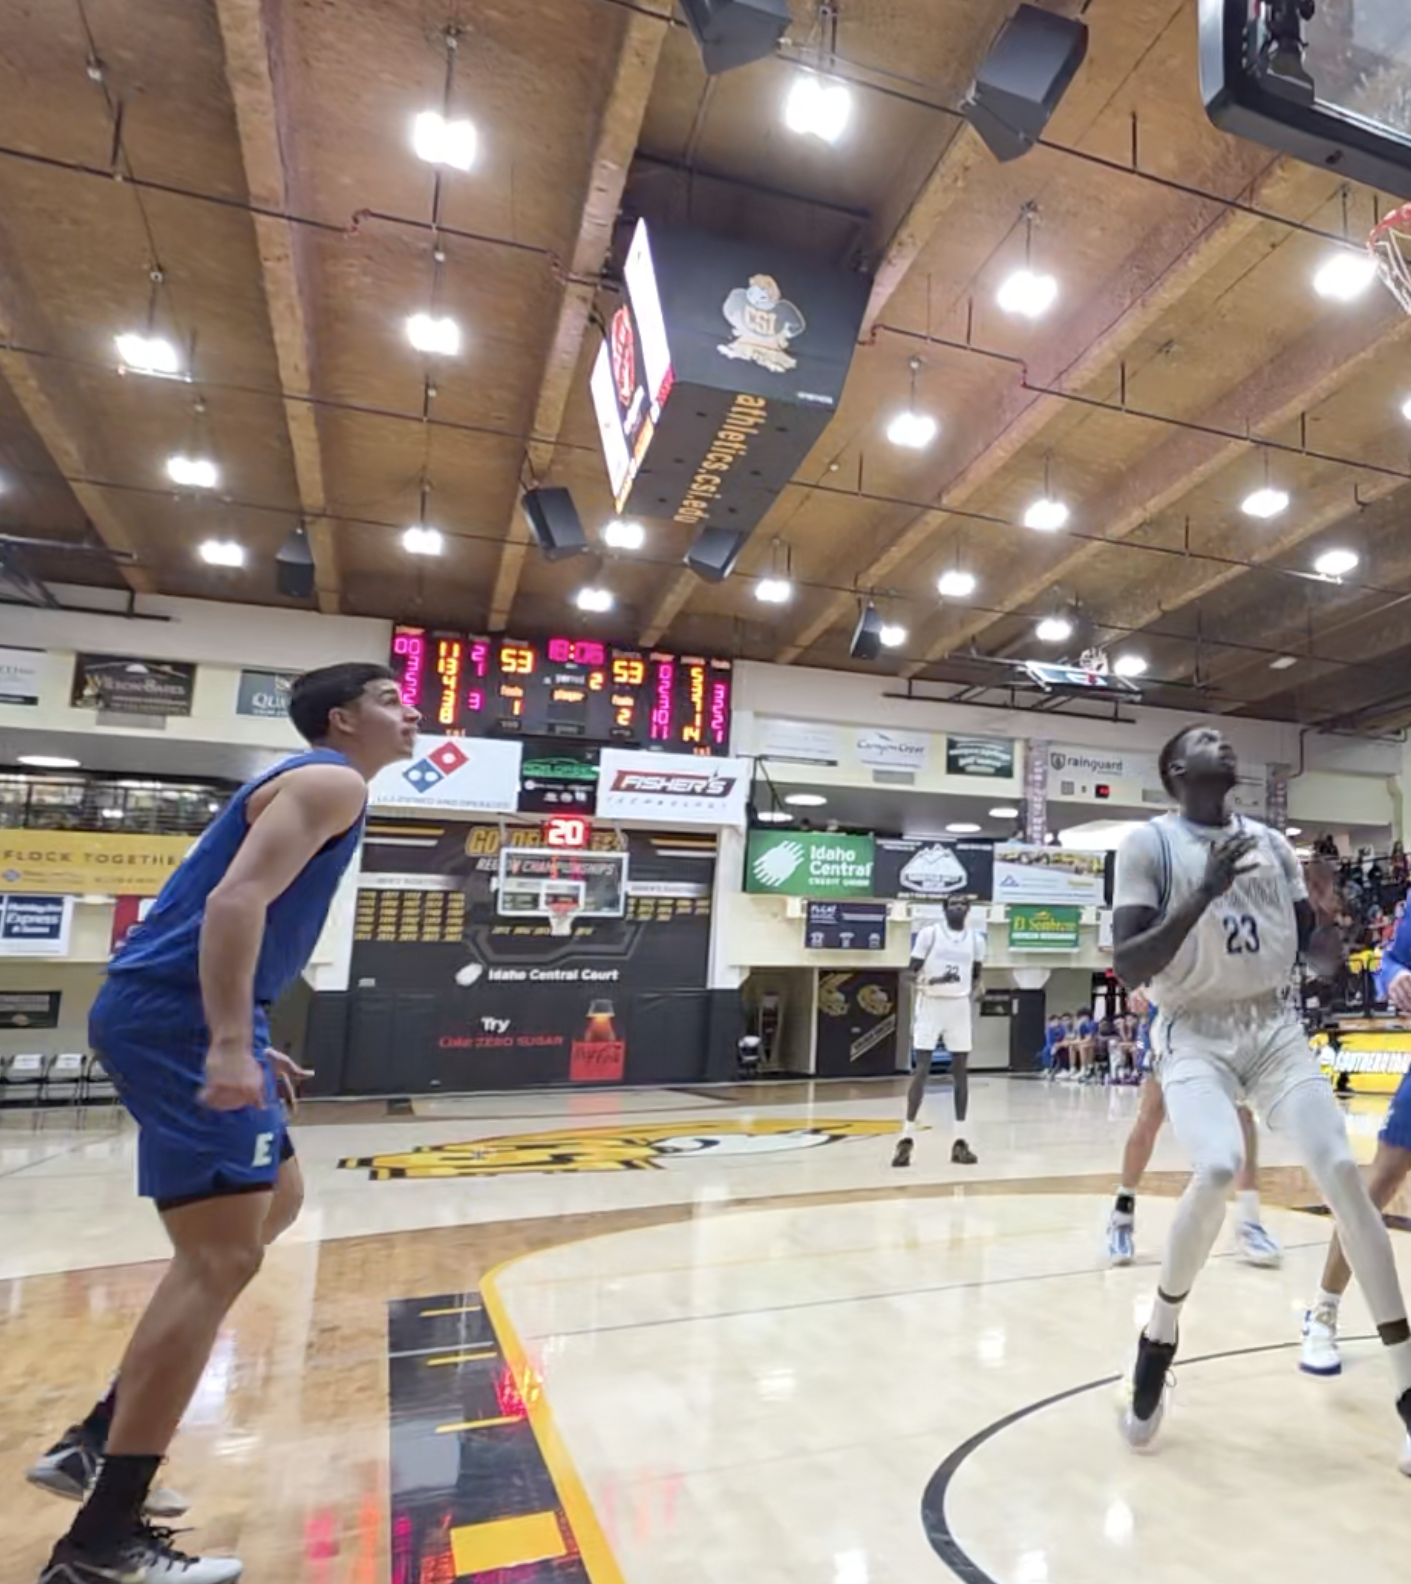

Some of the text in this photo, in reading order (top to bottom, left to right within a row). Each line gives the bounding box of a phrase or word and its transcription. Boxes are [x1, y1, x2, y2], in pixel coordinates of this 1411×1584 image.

[673, 394, 767, 524] athletics.csi.edu
[394, 638, 421, 654] 00
[439, 641, 460, 657] 11
[437, 658, 458, 675] 13
[500, 649, 534, 674] 53
[588, 671, 604, 690] 2
[612, 660, 644, 684] 53
[617, 708, 632, 725] 2
[1067, 756, 1123, 772] rainguard
[621, 772, 727, 794] FISHER'S
[548, 818, 586, 846] 20
[2, 849, 72, 862] FLOCK
[809, 845, 856, 861] Idaho
[808, 861, 875, 877] Central
[1222, 914, 1260, 954] 23
[488, 968, 620, 981] Idaho Central Court
[480, 1016, 511, 1034] Try
[251, 1131, 275, 1168] E
